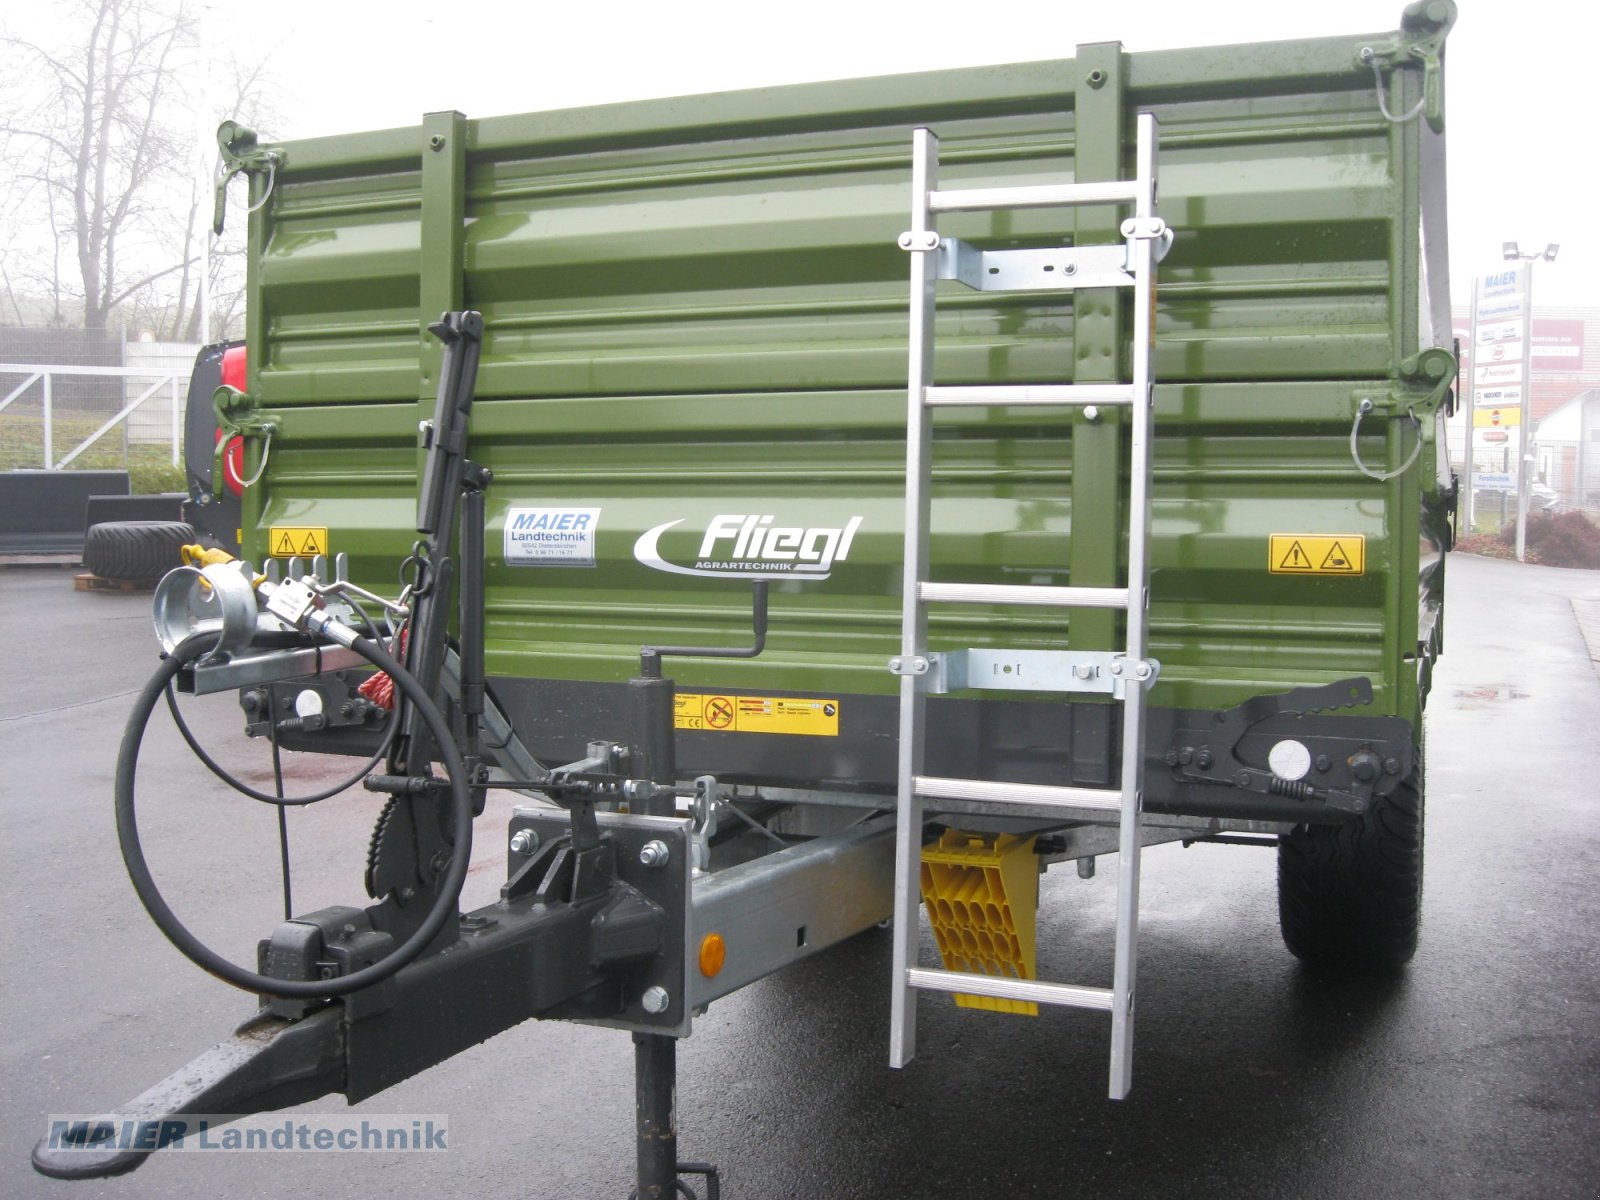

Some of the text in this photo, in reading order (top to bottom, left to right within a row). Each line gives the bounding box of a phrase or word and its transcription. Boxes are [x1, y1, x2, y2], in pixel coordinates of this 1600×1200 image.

[1484, 270, 1516, 289] MAIER
[512, 513, 592, 530] MAIER
[511, 531, 586, 541] Landtechnik
[698, 514, 864, 571] Fliegl
[694, 561, 794, 571] AGRARTECHNIK
